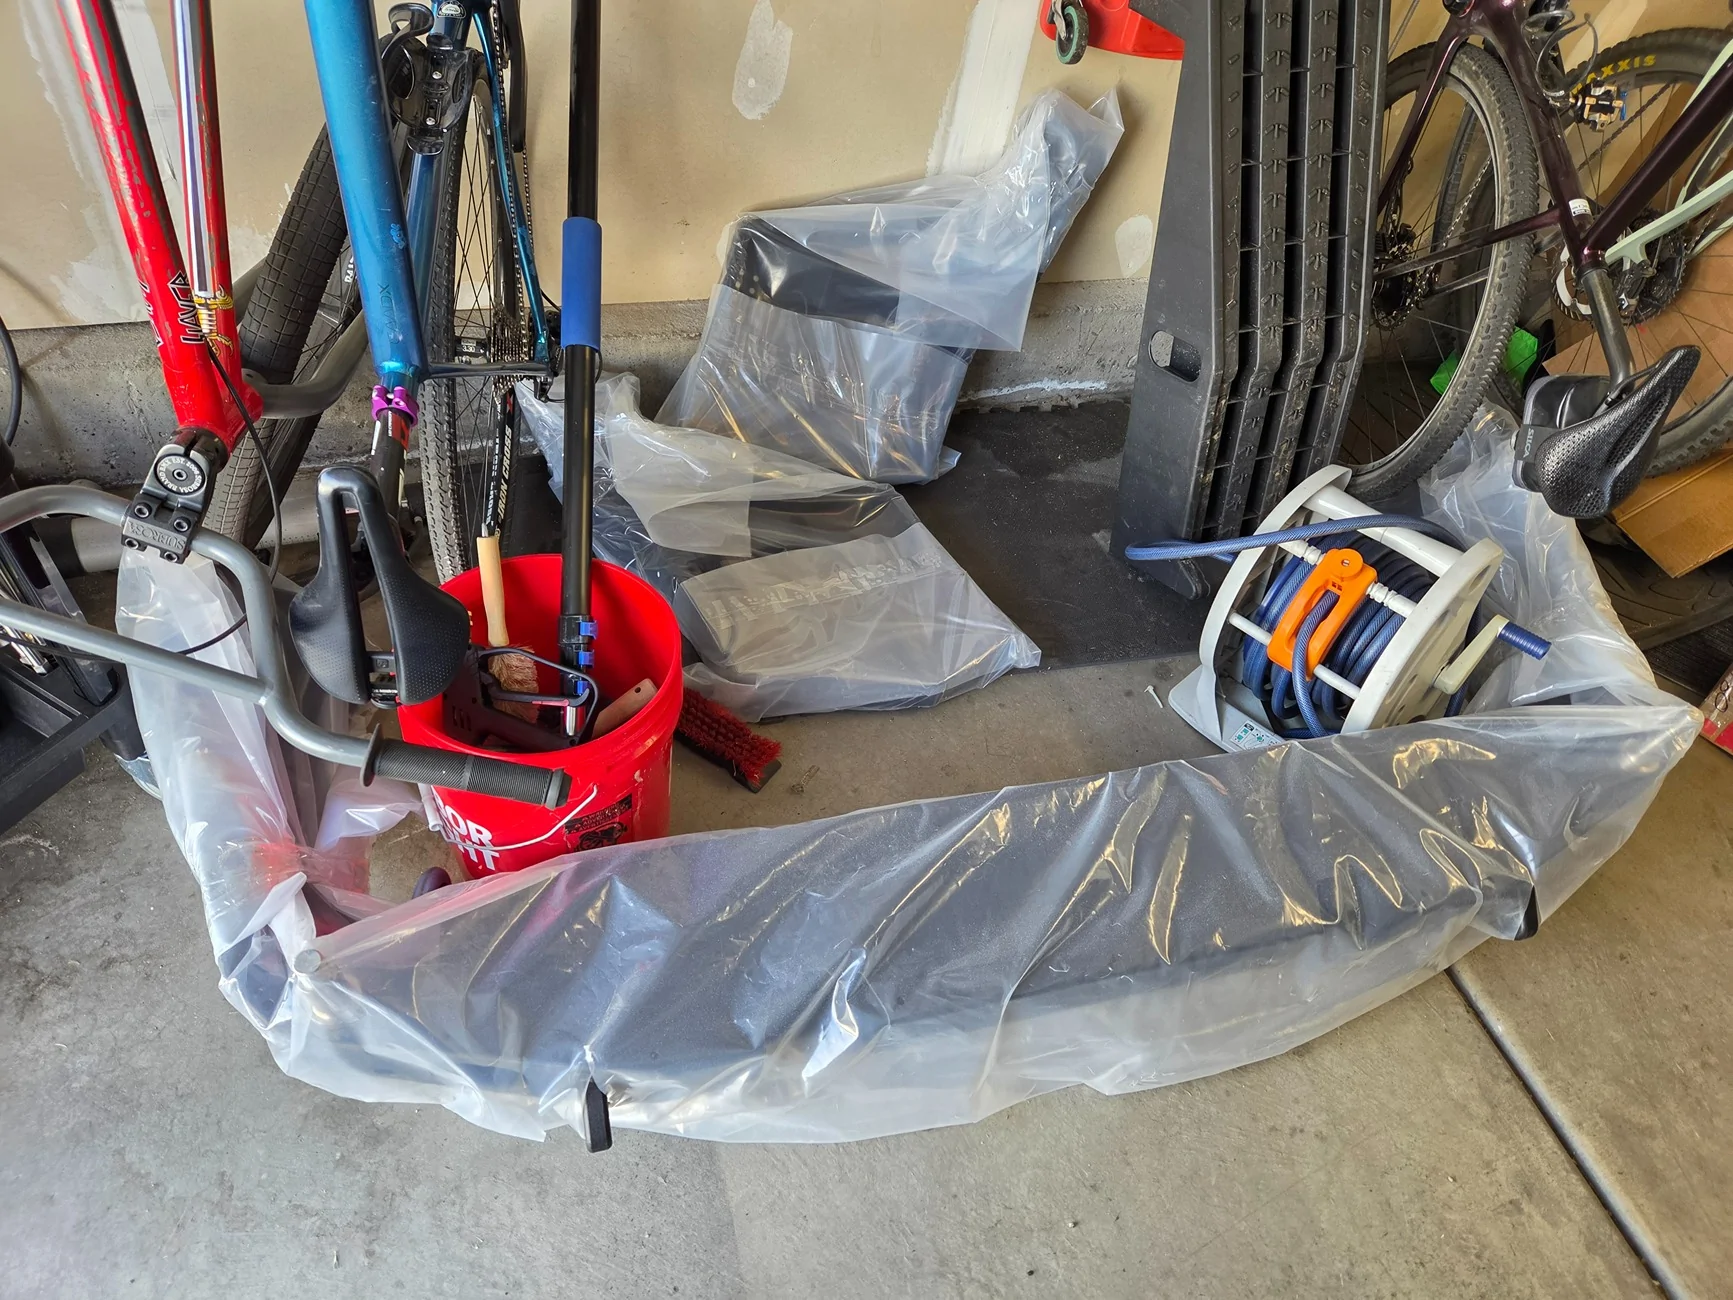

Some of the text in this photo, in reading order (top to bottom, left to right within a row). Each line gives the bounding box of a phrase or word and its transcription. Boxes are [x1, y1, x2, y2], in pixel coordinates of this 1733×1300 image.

[501, 424, 513, 480] CROSS
[1522, 427, 1535, 459] SILCA
[159, 471, 178, 492] BRAND
[127, 520, 187, 552] SUBROSA
